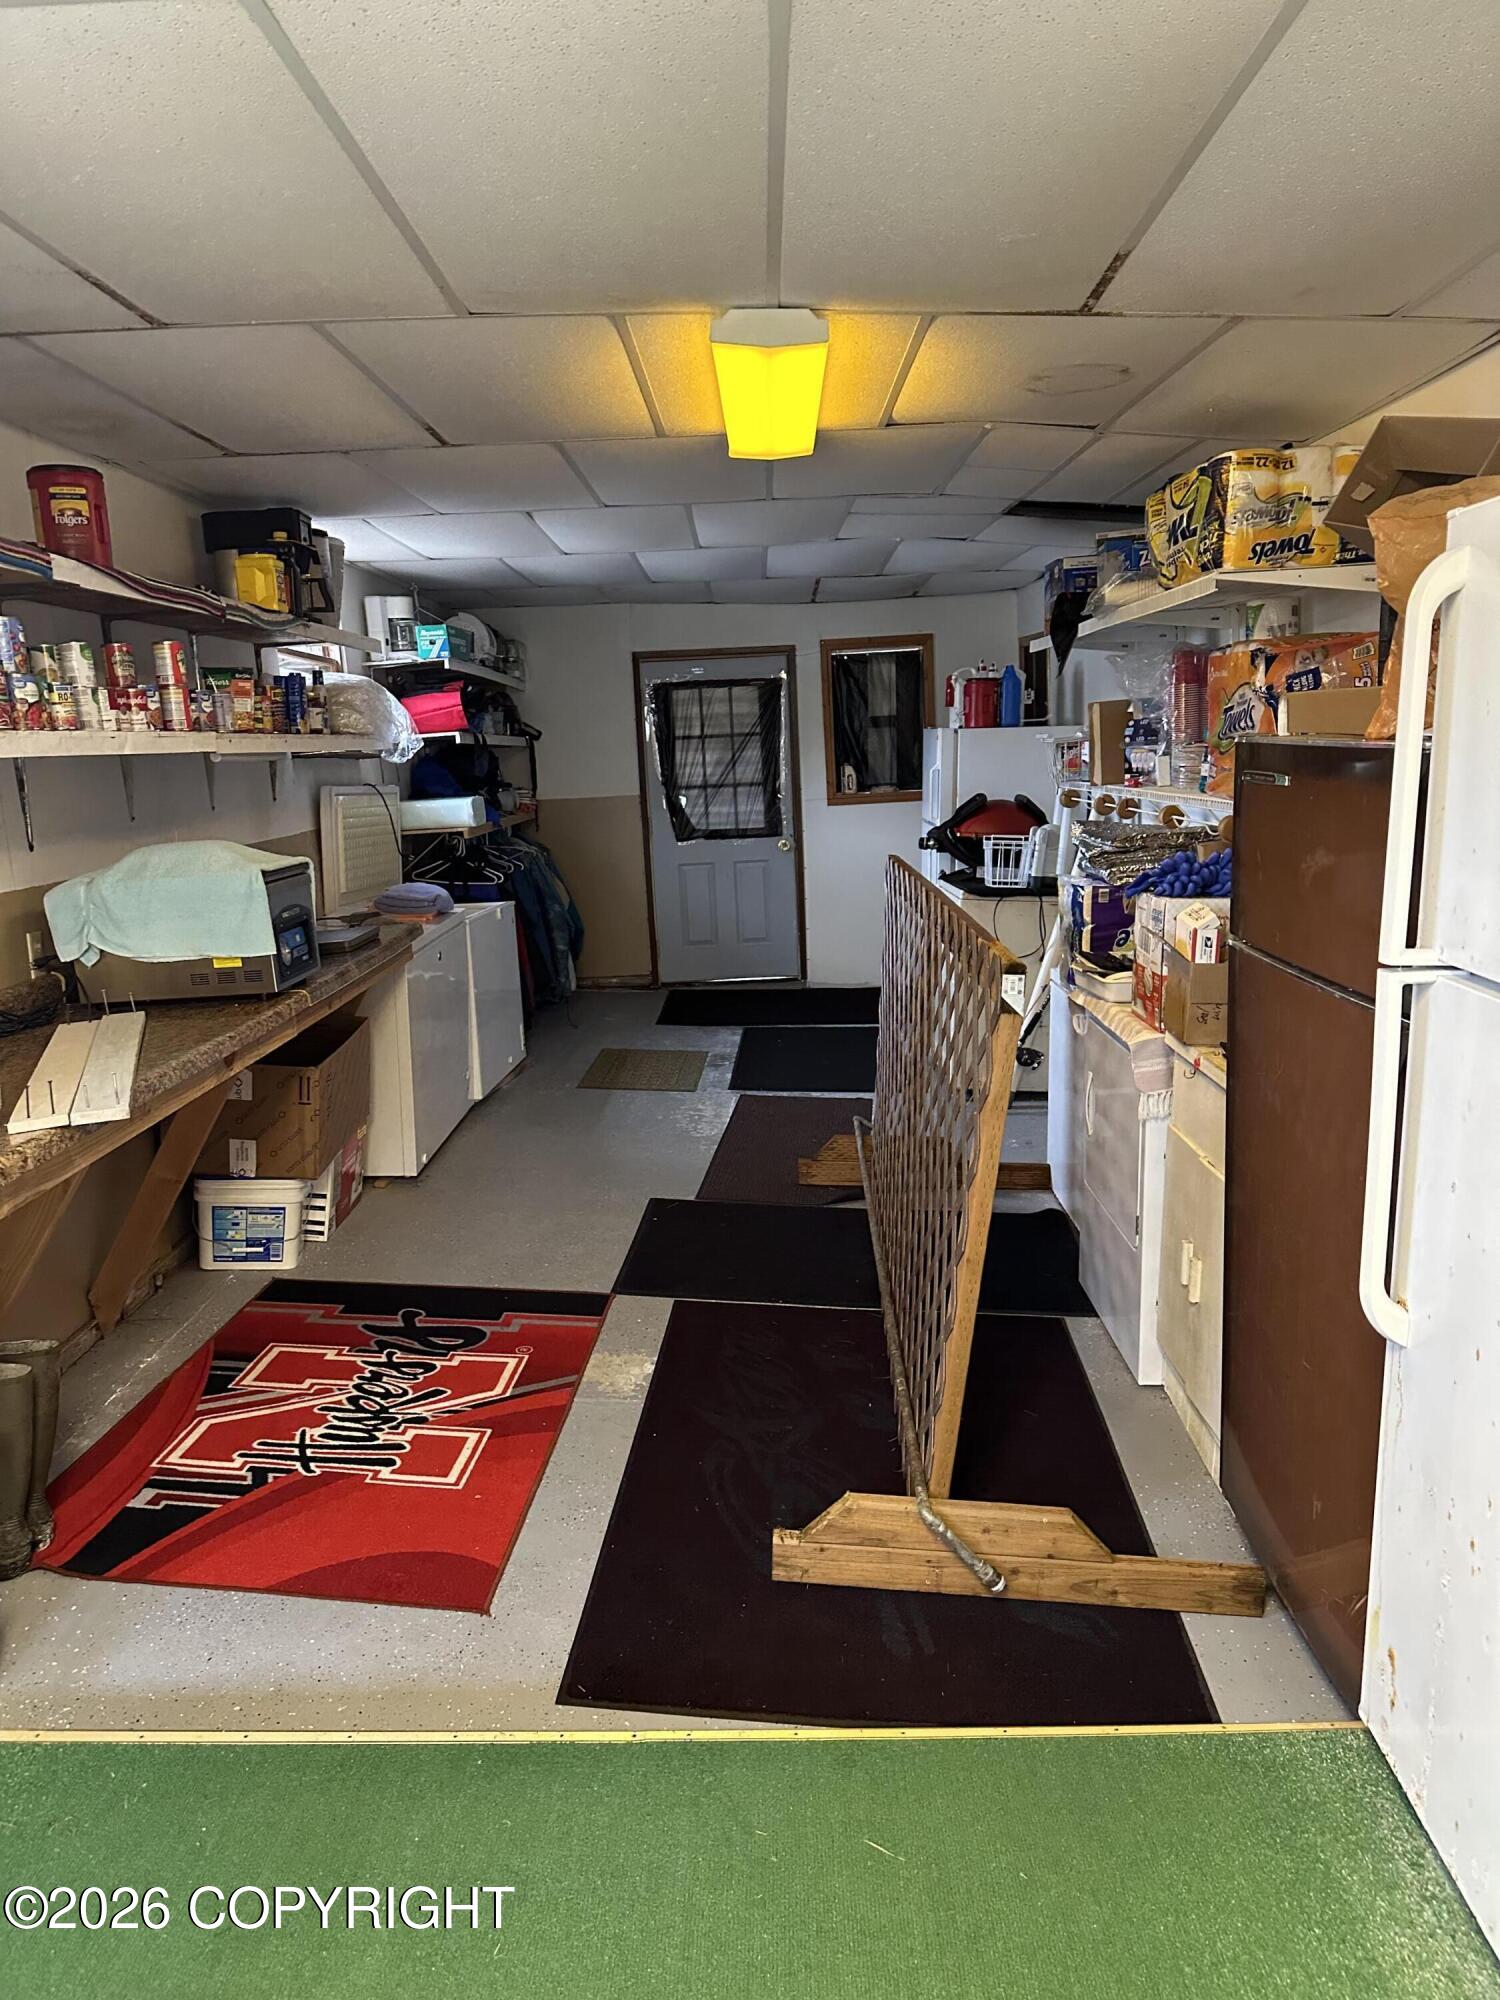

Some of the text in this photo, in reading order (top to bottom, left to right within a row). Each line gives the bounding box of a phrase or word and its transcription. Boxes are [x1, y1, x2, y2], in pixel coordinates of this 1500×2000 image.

[55, 512, 88, 527] Folgers
[1248, 528, 1317, 566] Towels
[1218, 697, 1256, 740] Towels
[233, 1349, 451, 1476] Huskers
